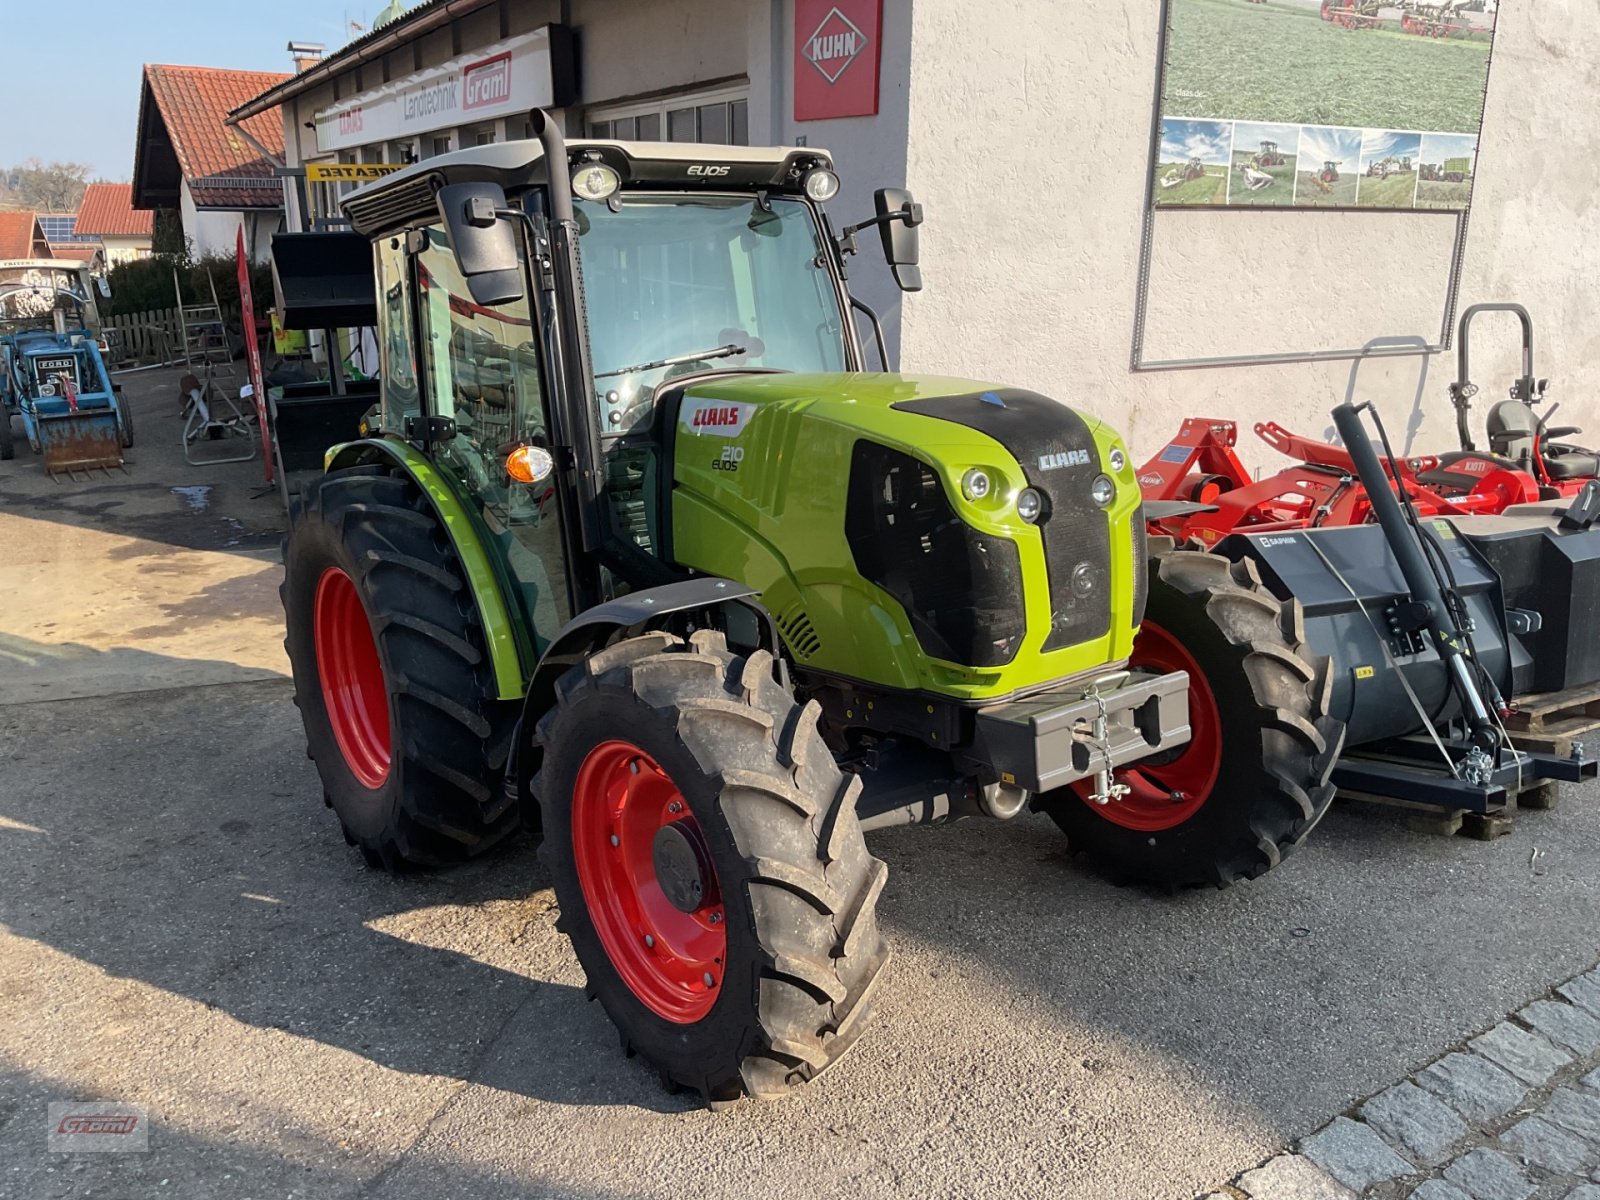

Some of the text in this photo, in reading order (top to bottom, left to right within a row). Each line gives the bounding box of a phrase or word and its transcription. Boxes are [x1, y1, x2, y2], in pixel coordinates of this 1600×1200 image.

[812, 31, 856, 61] KUHN
[403, 58, 510, 120] Landtechnik Graml
[687, 165, 731, 176] ELIOS
[40, 360, 72, 368] FORD
[693, 407, 739, 426] CLAAS
[721, 445, 745, 462] 210
[1038, 449, 1091, 471] CLAAS
[711, 459, 738, 471] ELIOS
